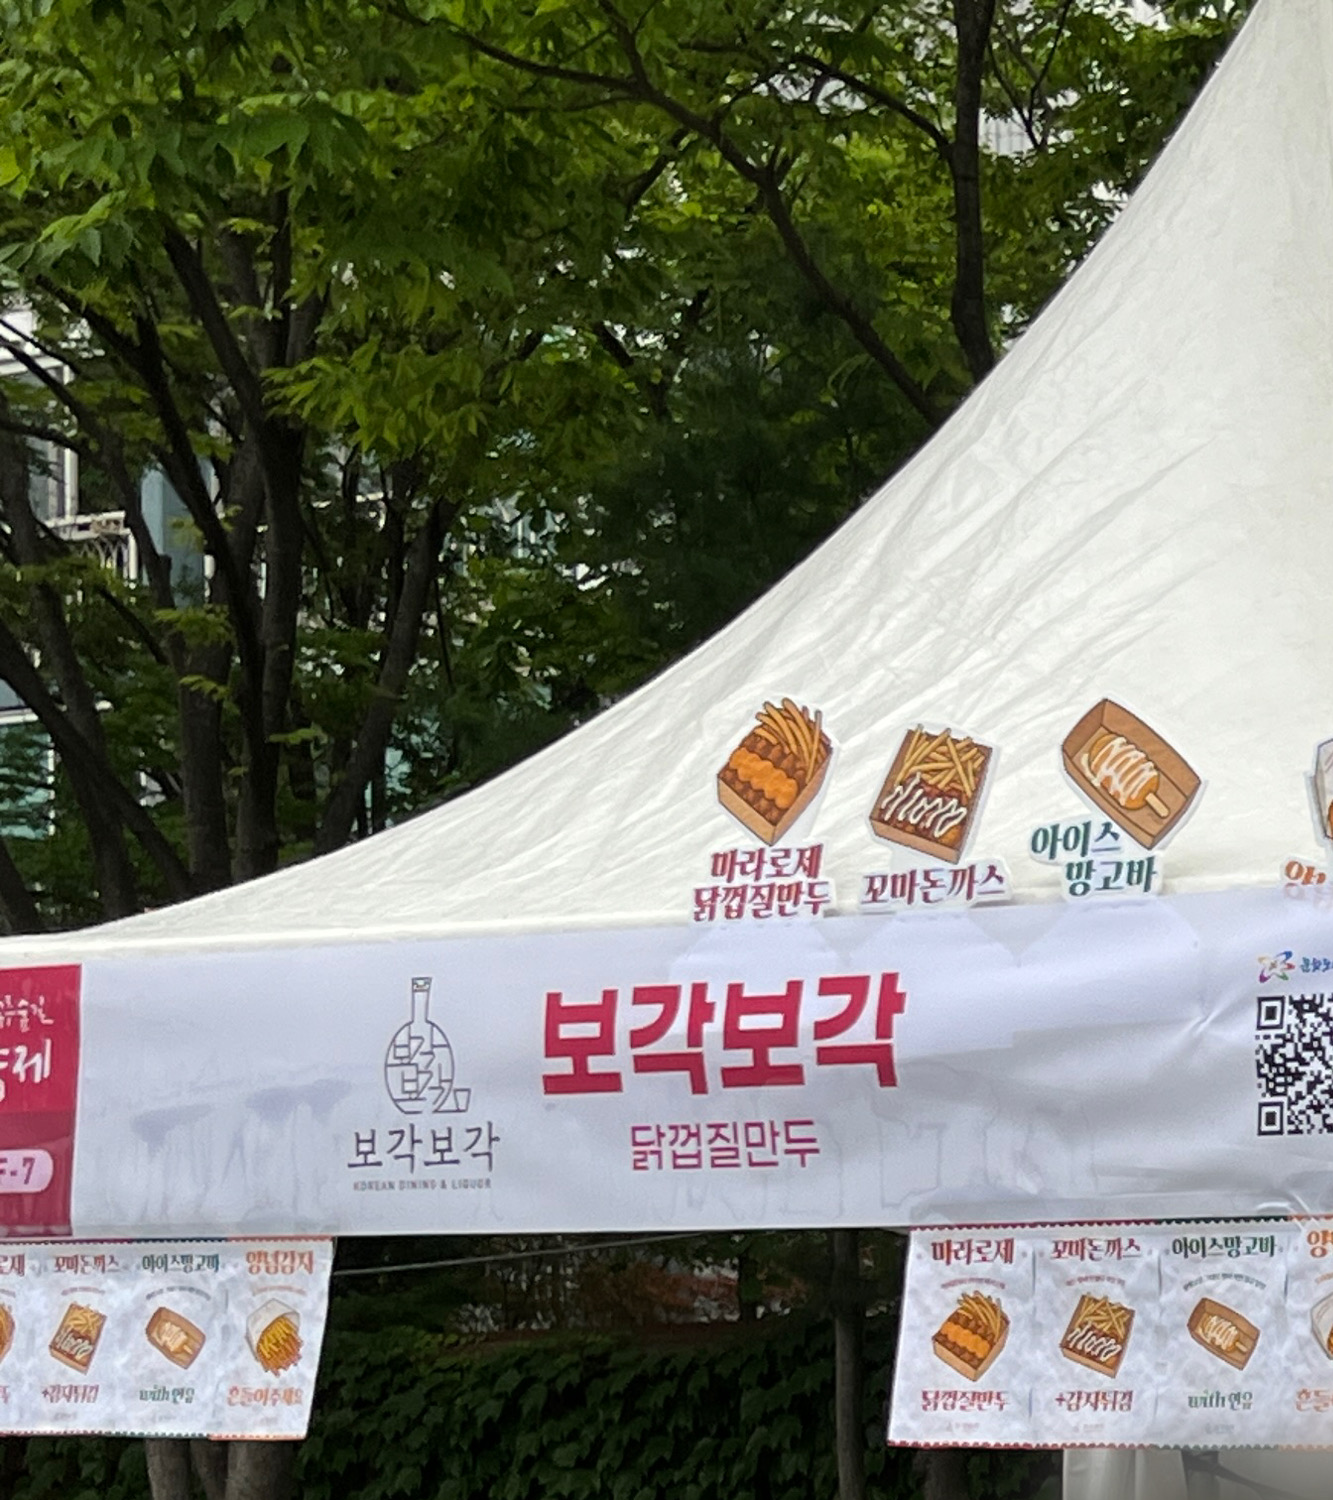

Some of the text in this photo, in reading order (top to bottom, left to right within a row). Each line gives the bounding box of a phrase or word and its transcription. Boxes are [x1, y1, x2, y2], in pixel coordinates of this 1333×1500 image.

[1030, 816, 1121, 862] 아이스
[711, 843, 824, 884] 마라로제
[861, 863, 1006, 906] 꼬마돈까스
[1065, 855, 1157, 896] 망고바
[693, 880, 831, 920] 닭껍질만두
[541, 971, 907, 1094] 보각보각
[348, 1121, 501, 1174] 보각보각
[630, 1119, 821, 1171] 닭껍질만두
